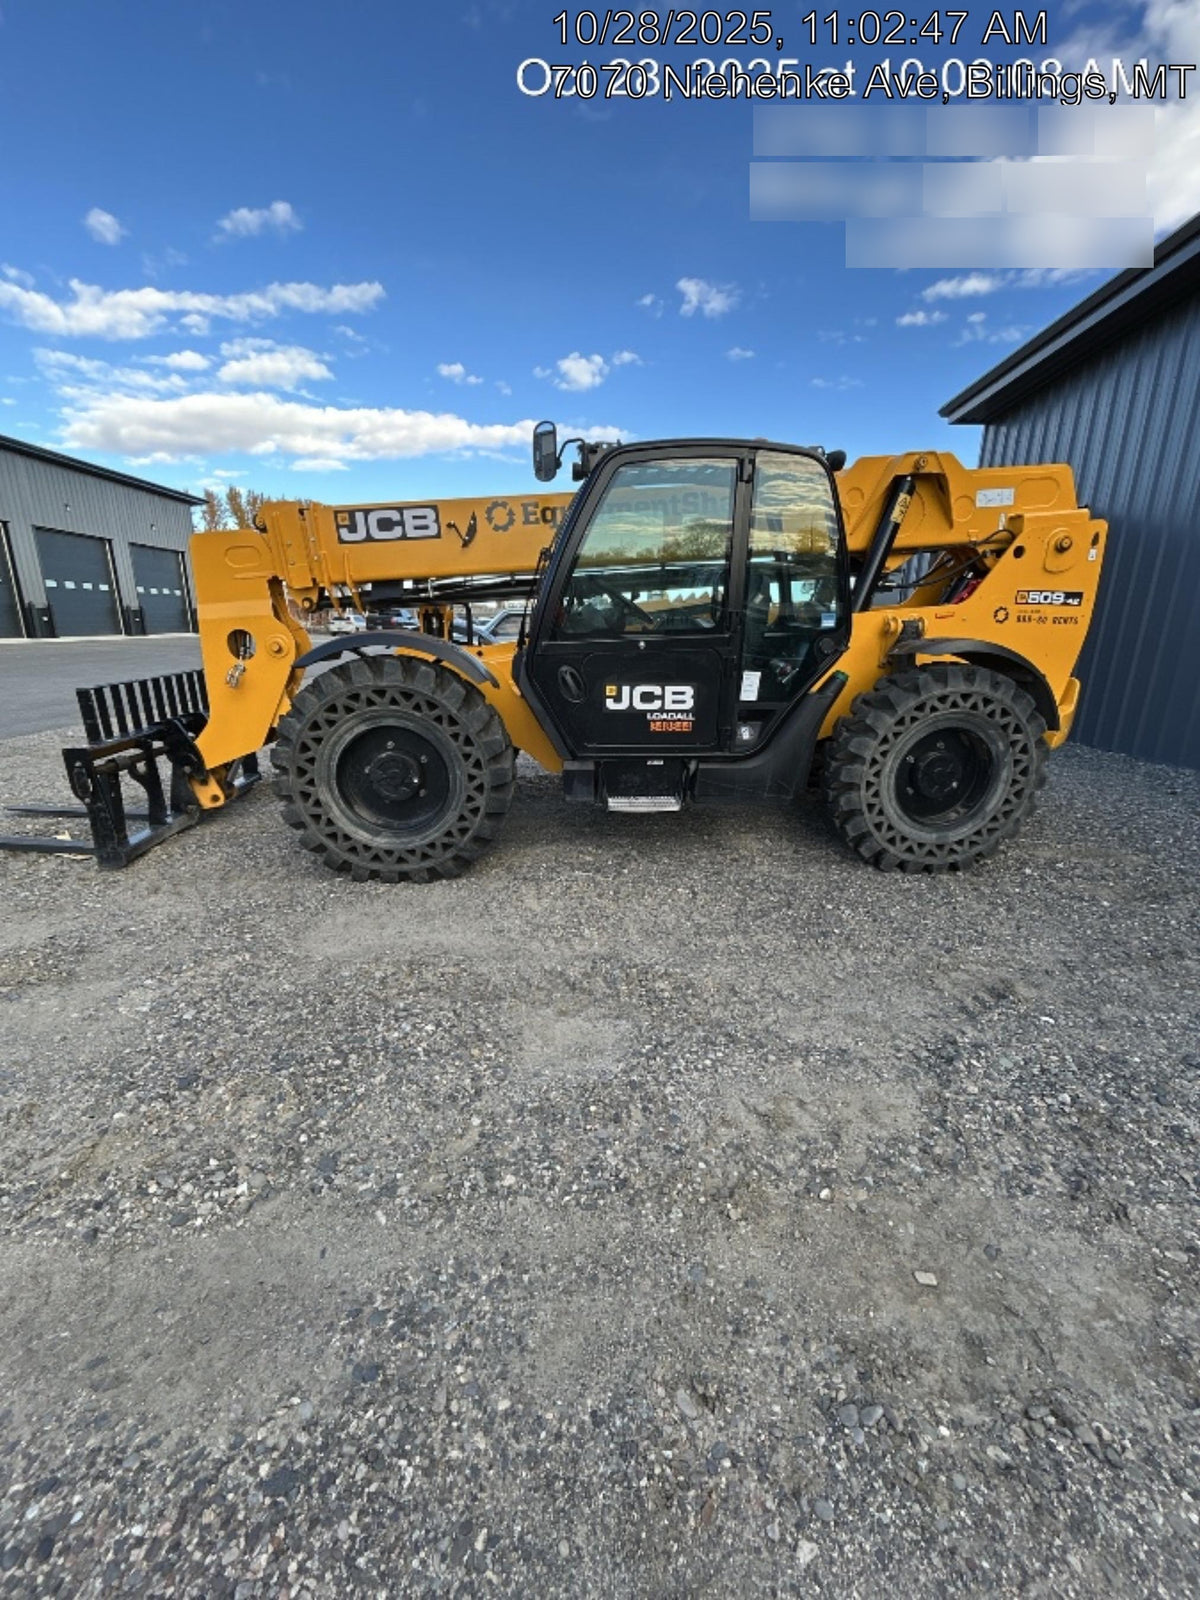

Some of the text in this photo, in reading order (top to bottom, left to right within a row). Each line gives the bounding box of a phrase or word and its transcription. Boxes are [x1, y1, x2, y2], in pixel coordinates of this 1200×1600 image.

[338, 507, 438, 542] JCB
[605, 684, 695, 711] JCB
[646, 712, 696, 721] LOADALL
